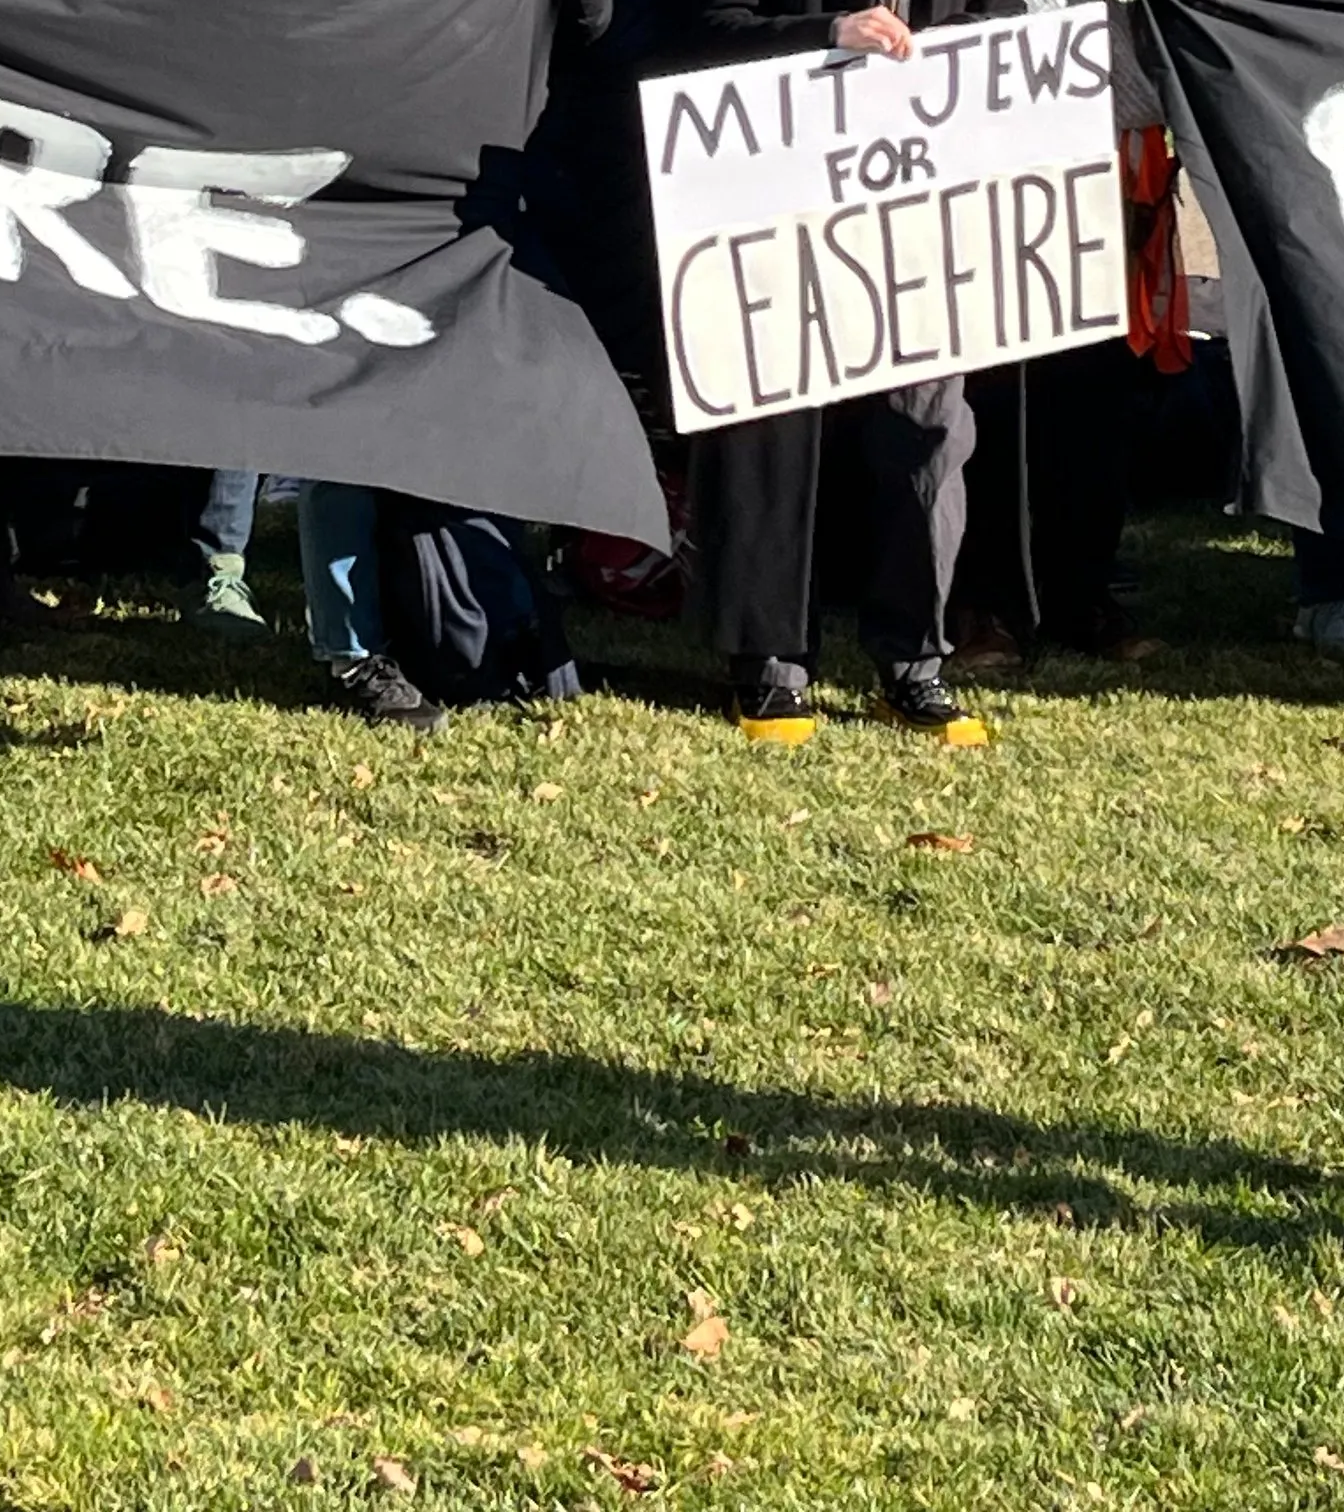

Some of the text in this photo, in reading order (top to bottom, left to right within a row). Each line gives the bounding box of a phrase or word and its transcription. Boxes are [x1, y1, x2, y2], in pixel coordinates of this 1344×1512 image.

[660, 18, 1112, 175] MIT JEWS
[823, 136, 937, 203] FOR
[670, 161, 1120, 417] CEASEFIRE
